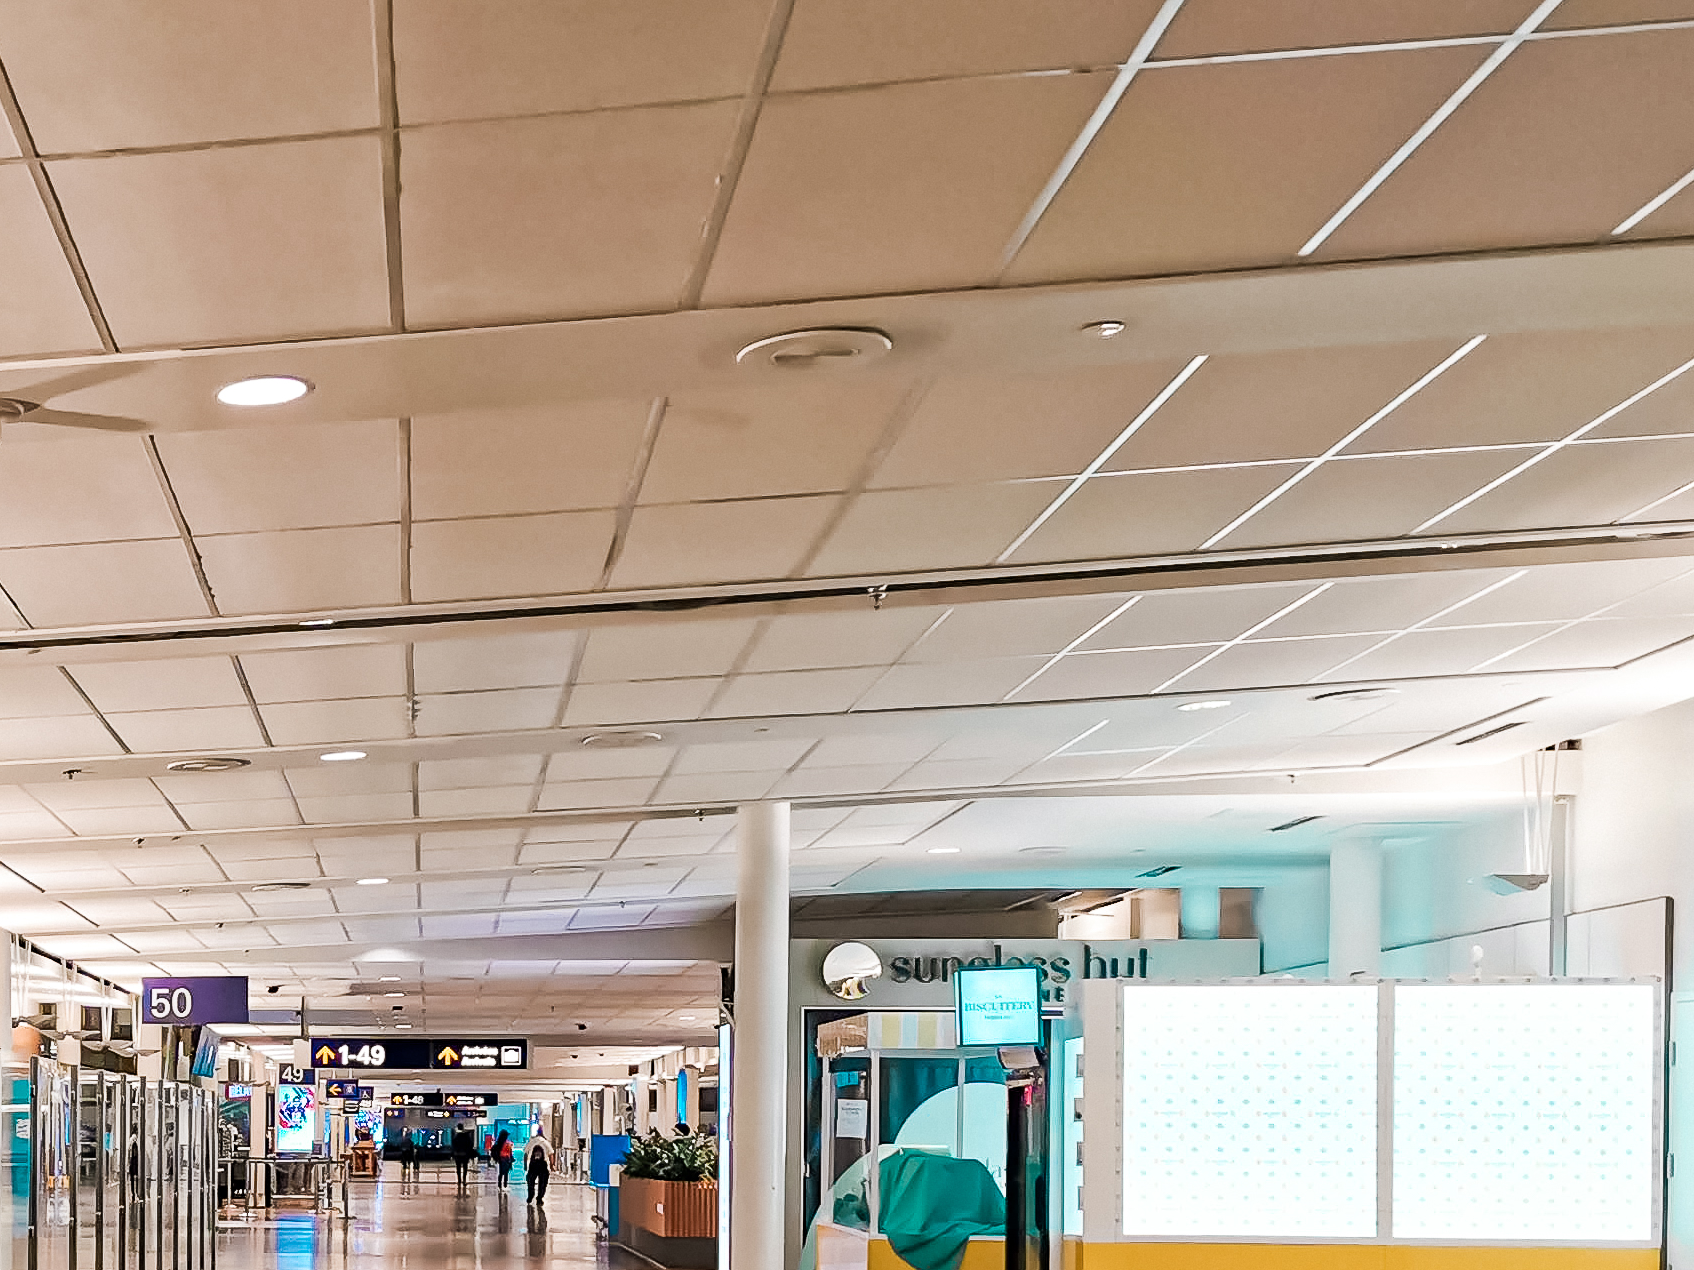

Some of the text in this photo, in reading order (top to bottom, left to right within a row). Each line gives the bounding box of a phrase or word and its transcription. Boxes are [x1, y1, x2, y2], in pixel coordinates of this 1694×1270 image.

[890, 944, 1148, 984] sunlss hut
[150, 987, 193, 1019] 50
[337, 1044, 386, 1066] 1-49
[281, 1065, 304, 1083] 49
